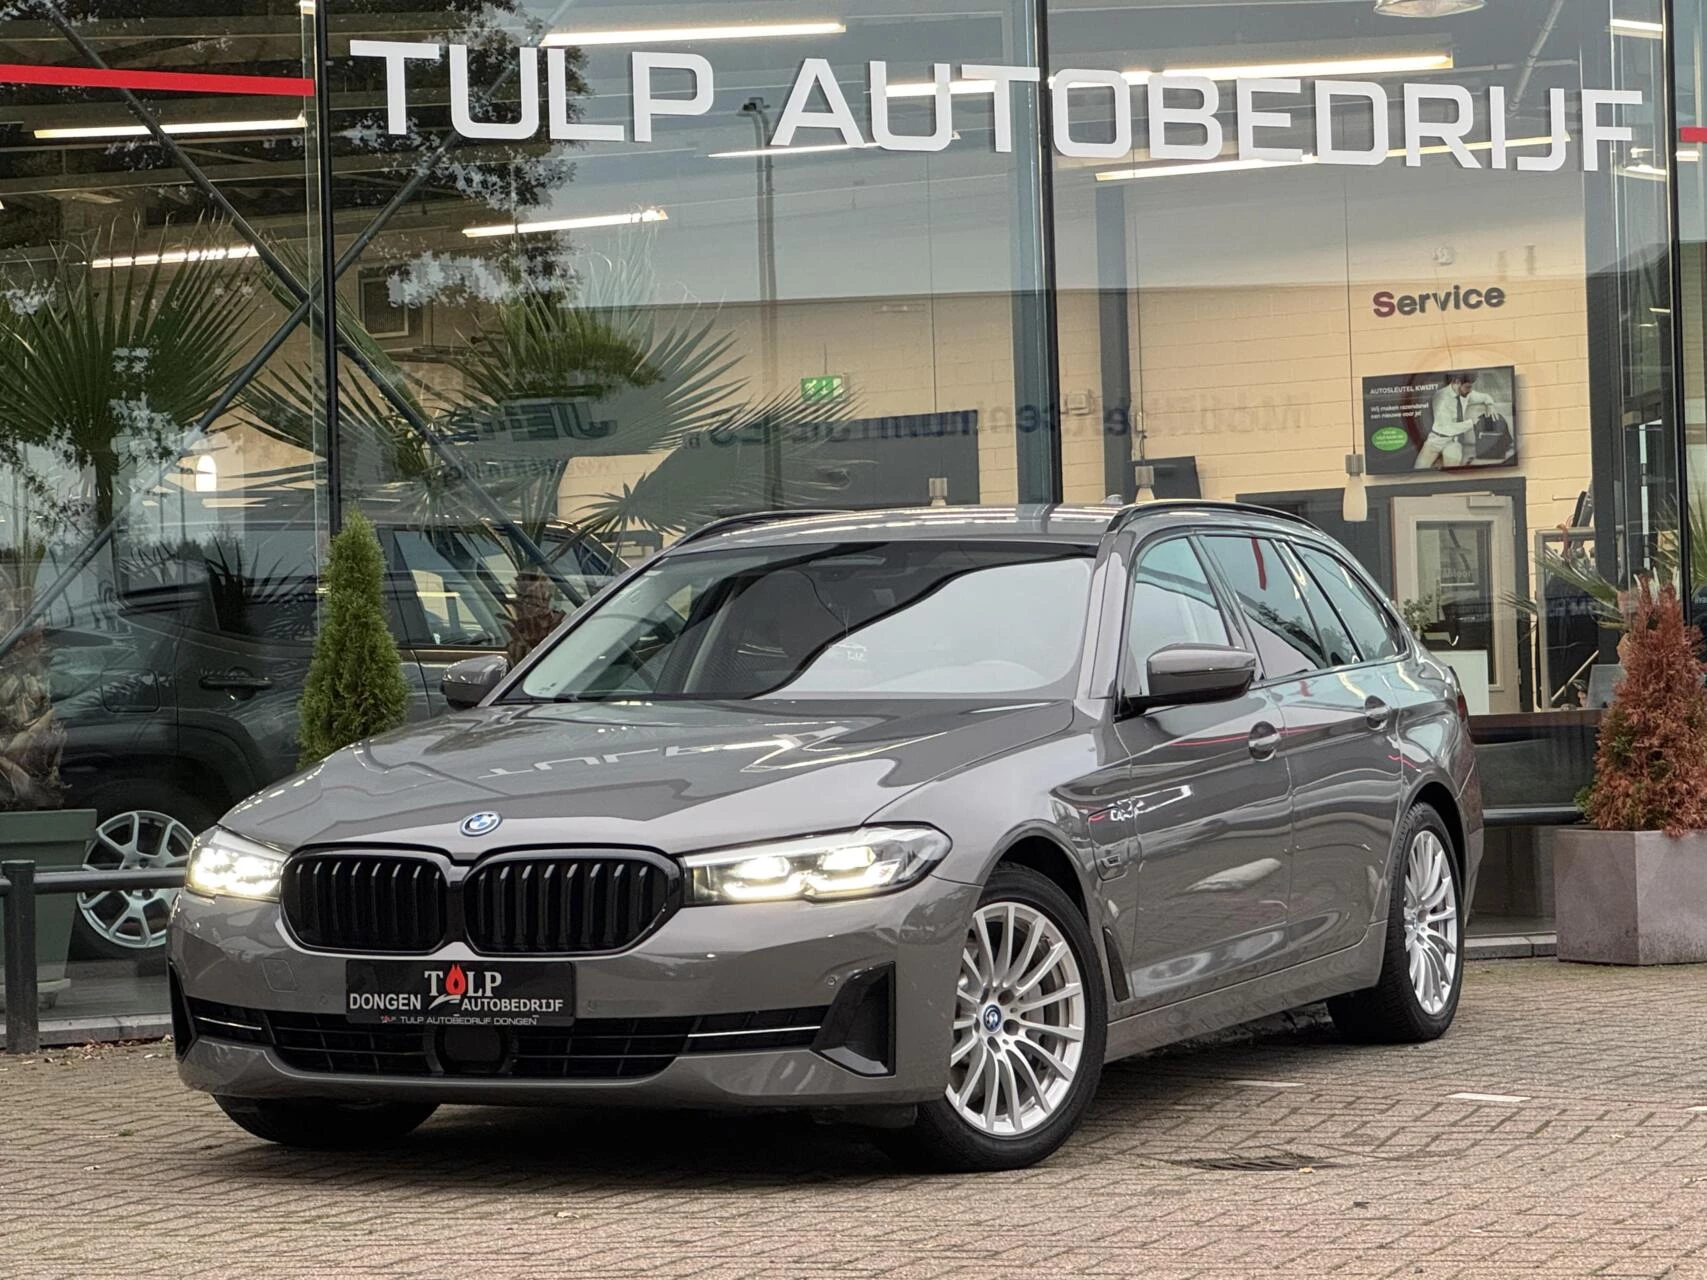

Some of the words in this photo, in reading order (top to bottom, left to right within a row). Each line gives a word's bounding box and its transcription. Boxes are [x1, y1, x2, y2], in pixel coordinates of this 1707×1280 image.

[350, 40, 714, 142] TULP
[770, 58, 1643, 171] AUTOBEDRIJF
[1373, 285, 1506, 318] Service
[1370, 385, 1415, 394] AUTOSLEUTEL
[350, 993, 421, 1010] DONGEN
[461, 998, 563, 1012] AUTOBEDRIJF
[400, 1016, 424, 1024] TULP
[426, 1016, 492, 1025] AUTOBEDRIJF
[494, 1017, 537, 1025] DONGEN
